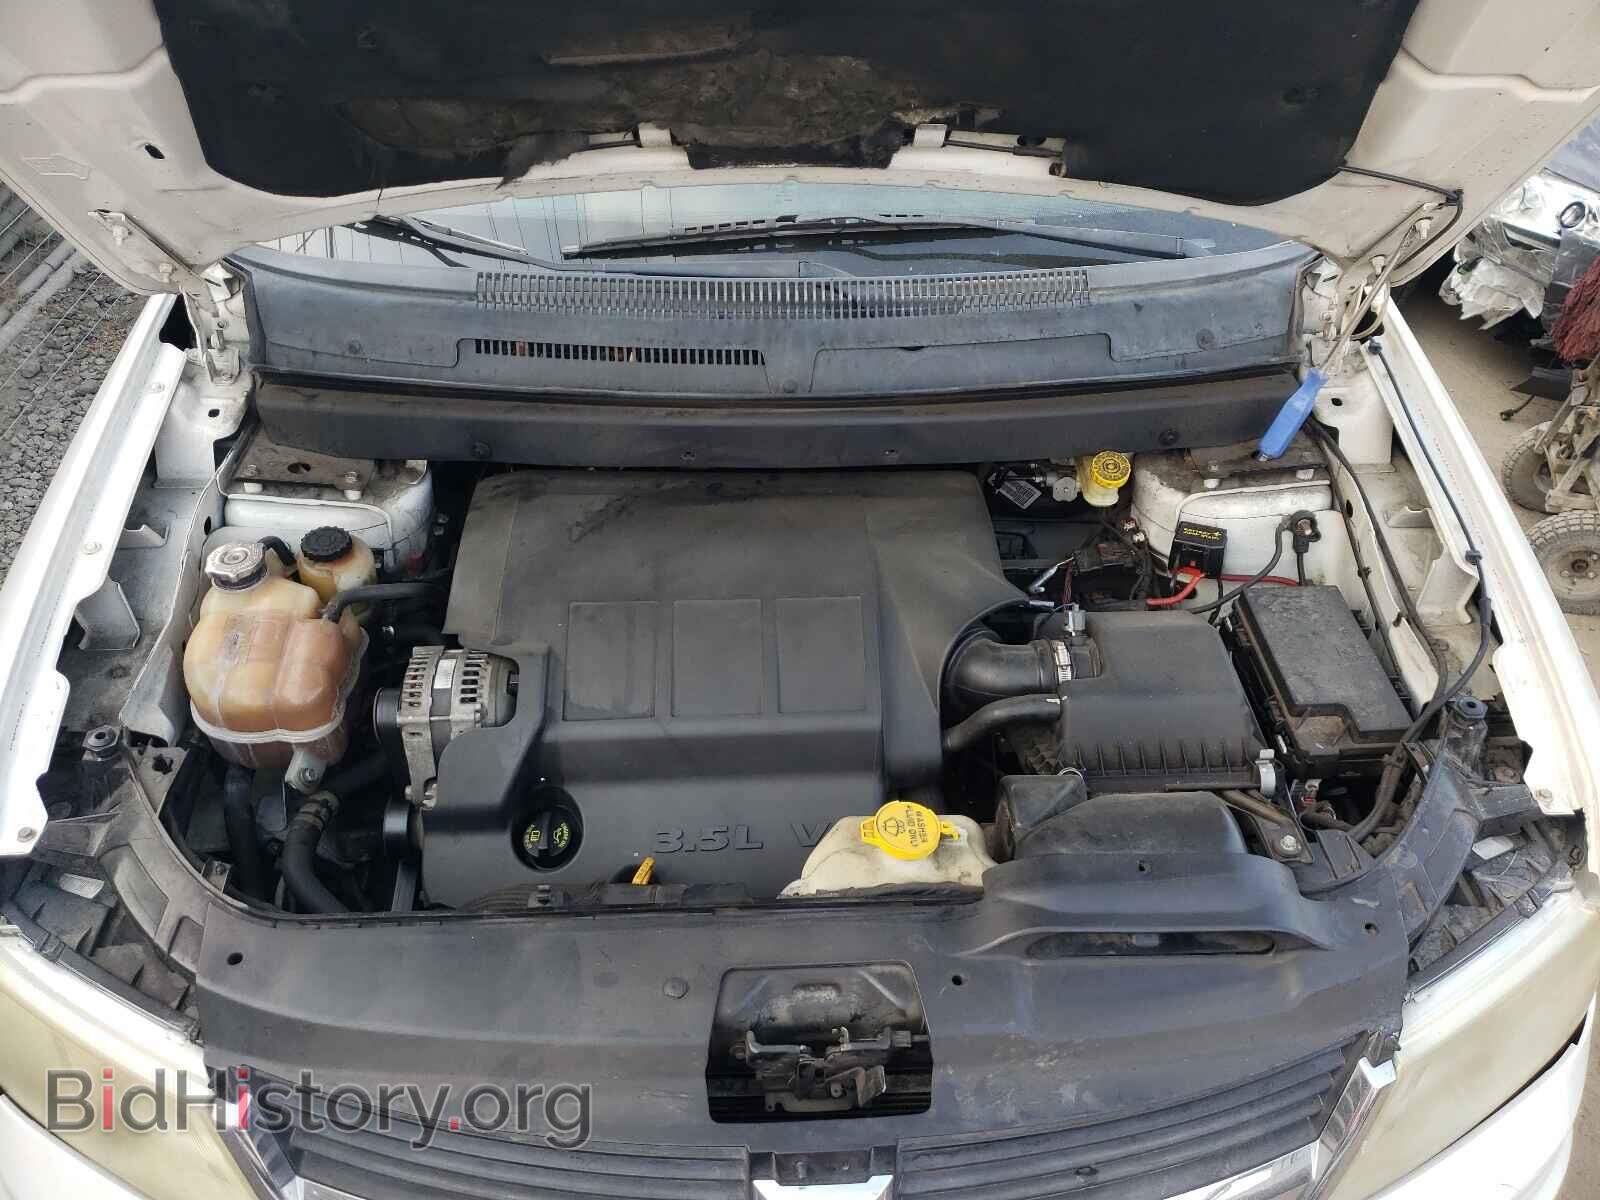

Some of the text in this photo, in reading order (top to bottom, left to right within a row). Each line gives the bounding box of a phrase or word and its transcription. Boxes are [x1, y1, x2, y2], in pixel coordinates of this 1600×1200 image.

[652, 823, 764, 854] 3.5L
[908, 828, 919, 847] ONLY
[916, 811, 928, 843] WASHER
